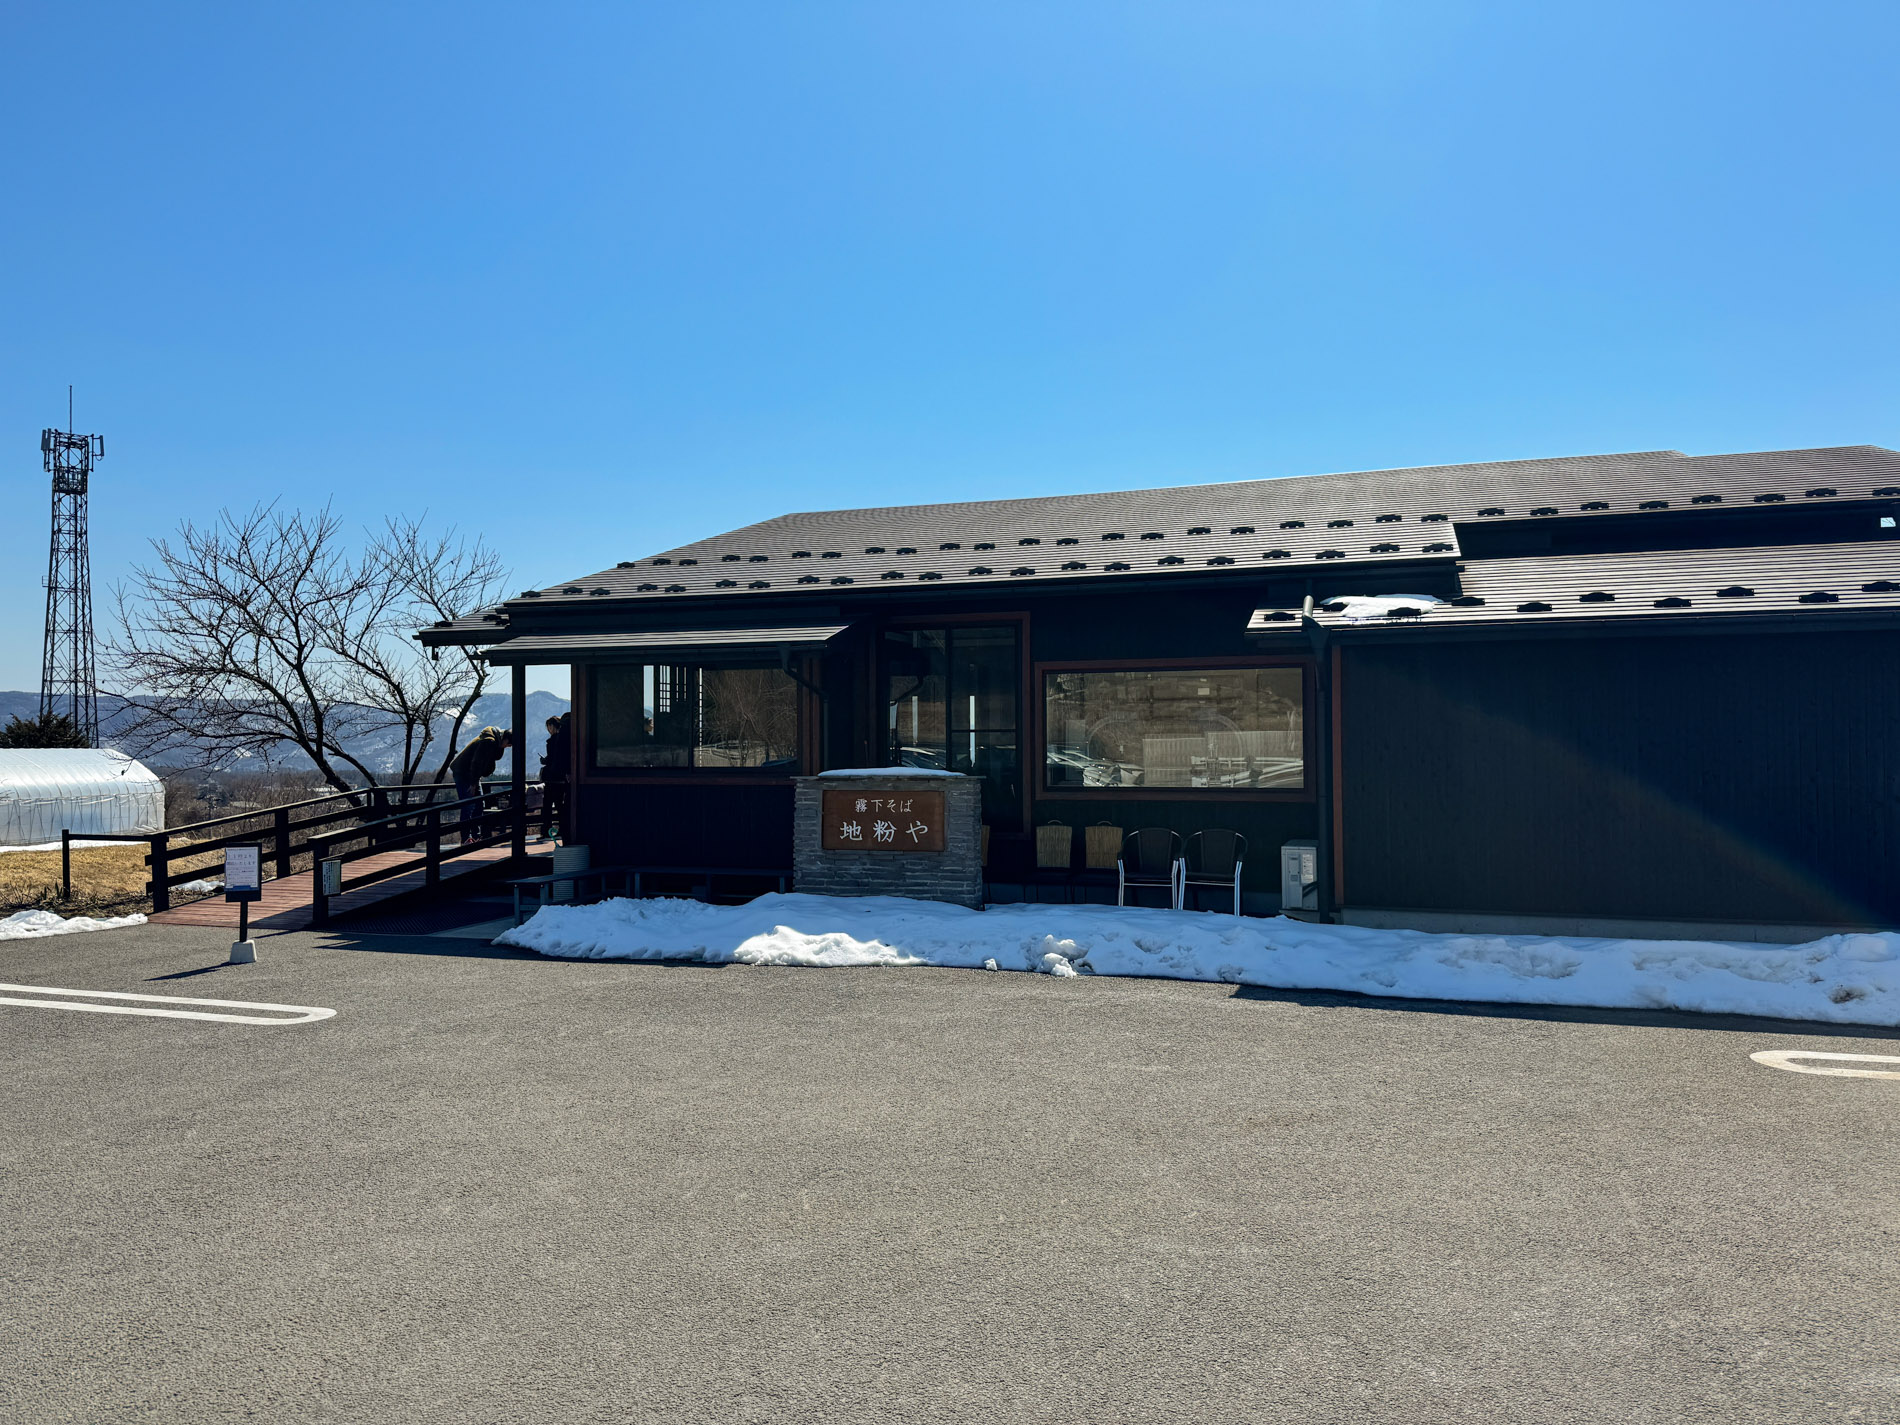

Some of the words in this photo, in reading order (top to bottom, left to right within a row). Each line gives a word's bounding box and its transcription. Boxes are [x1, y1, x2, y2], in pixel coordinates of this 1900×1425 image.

[855, 798, 913, 813] 霧下そば
[840, 819, 928, 843] 地粉や
